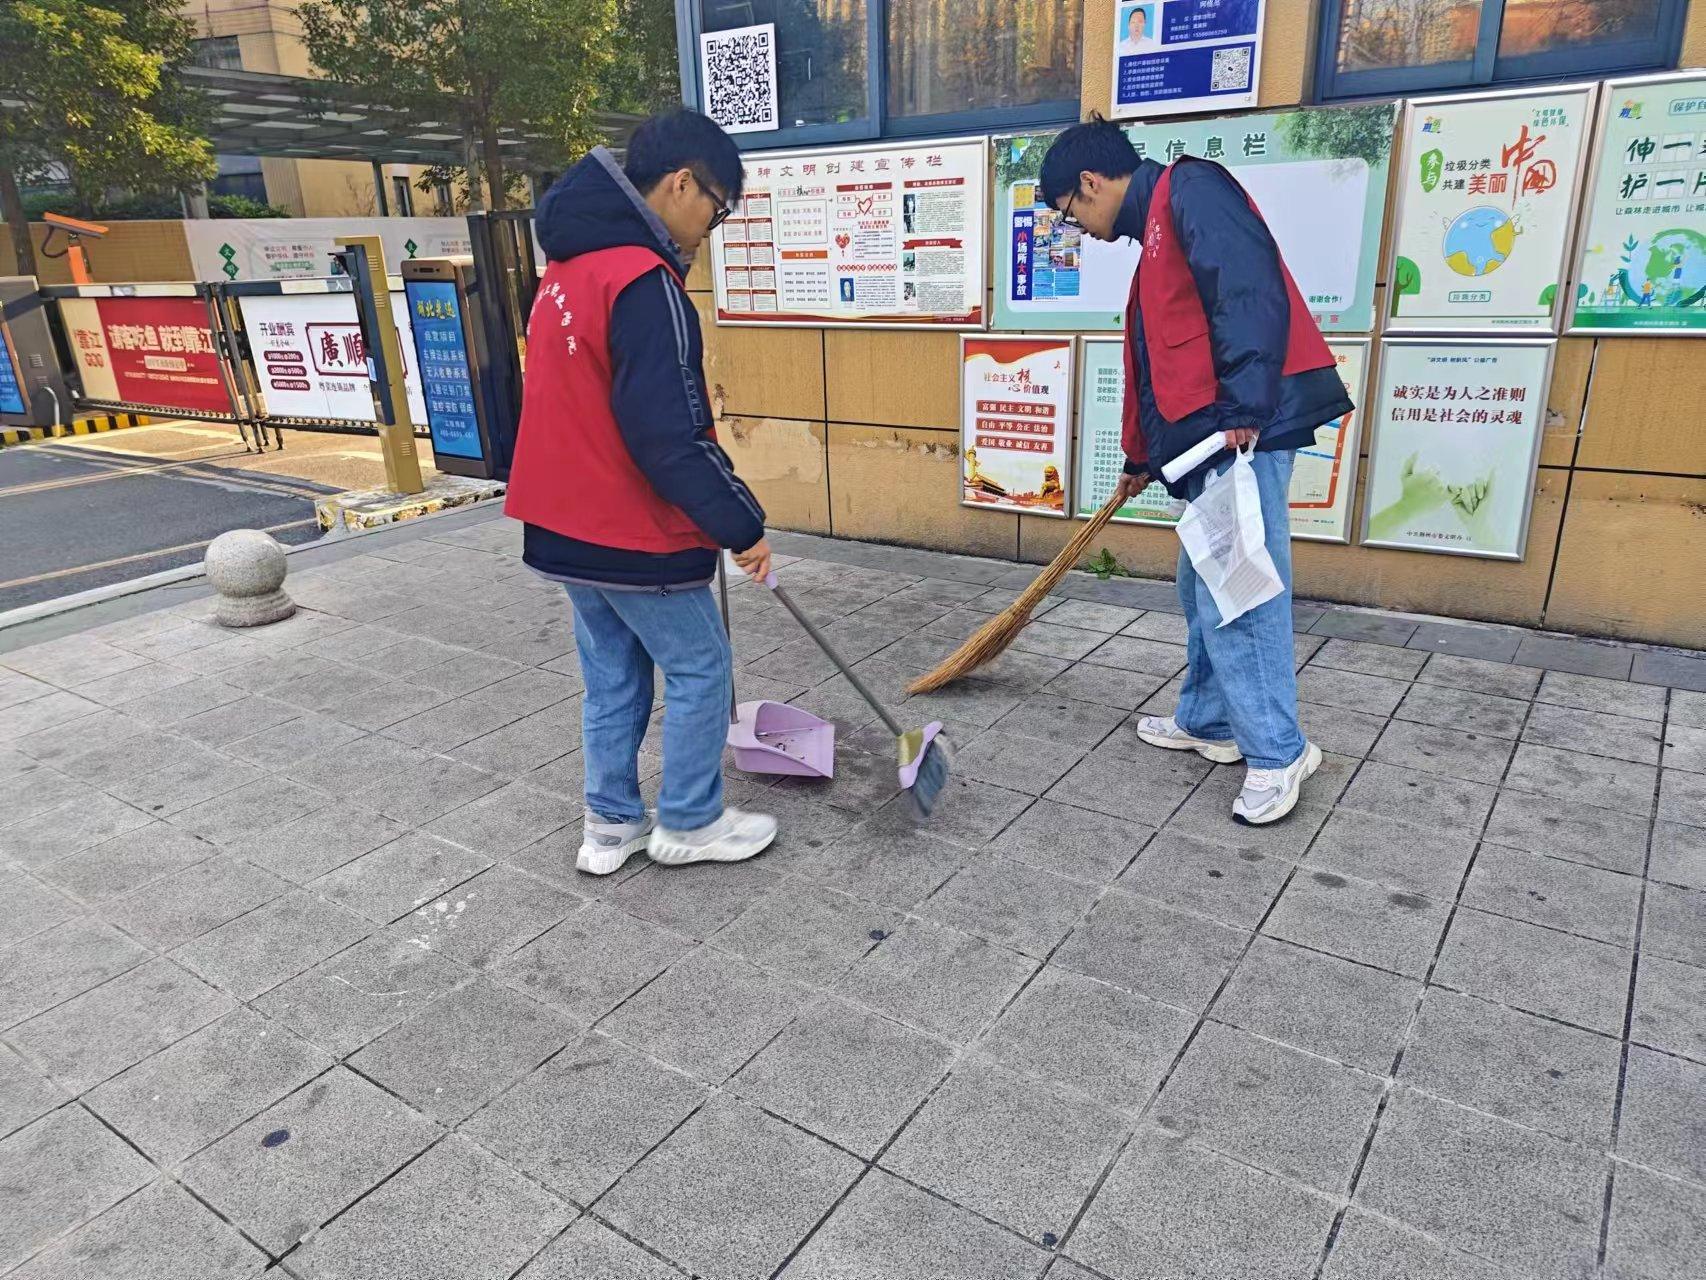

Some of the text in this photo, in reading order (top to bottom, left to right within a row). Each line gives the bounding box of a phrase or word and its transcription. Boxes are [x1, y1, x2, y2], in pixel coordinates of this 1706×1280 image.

[743, 155, 946, 179] 神文明创建宣传栏
[1445, 158, 1491, 172] 垃圾分类
[1014, 216, 1033, 228] 警惕
[1017, 231, 1028, 297] 小场所大事故
[1394, 385, 1526, 402] 诚实是为人之准则
[982, 403, 996, 411] 富强
[1035, 407, 1050, 415] 和谐
[1391, 407, 1523, 424] 信用是社会的灵魂
[982, 421, 1048, 432] 自由 平等 公正 法治
[1034, 442, 1048, 450] 友善
